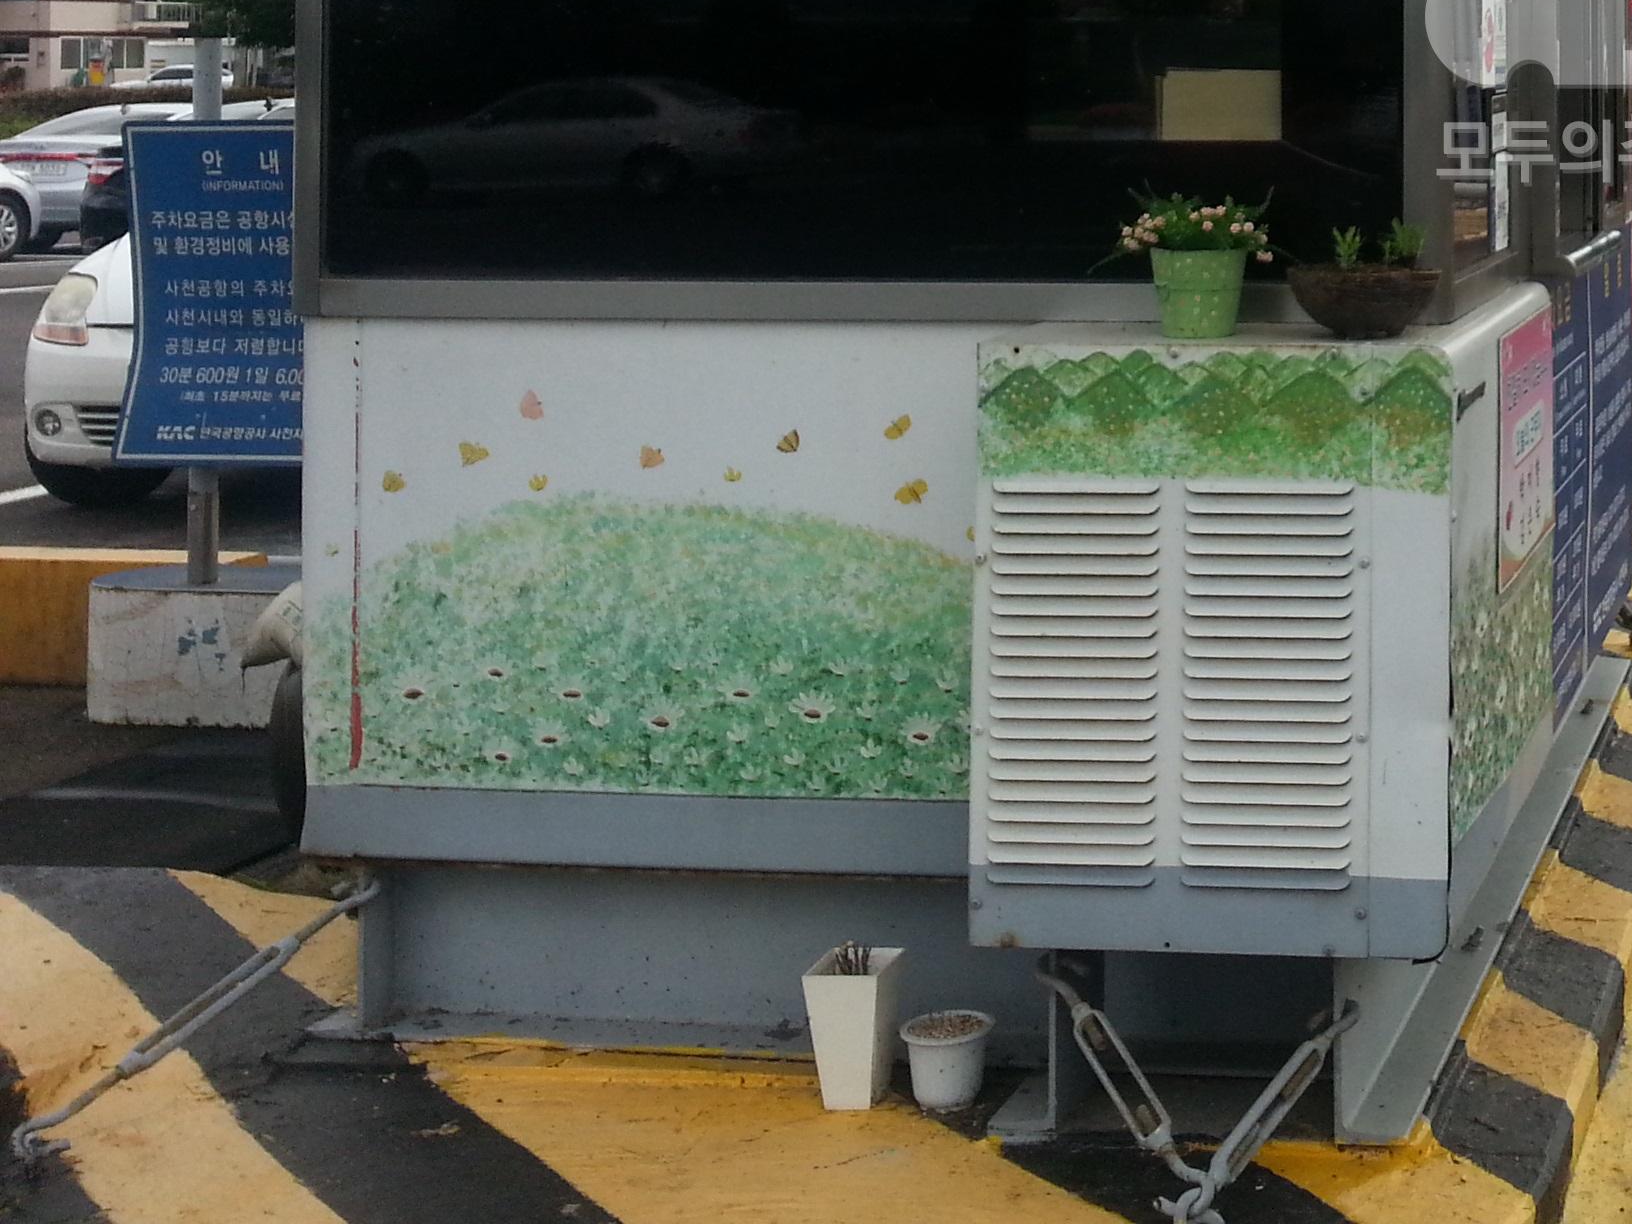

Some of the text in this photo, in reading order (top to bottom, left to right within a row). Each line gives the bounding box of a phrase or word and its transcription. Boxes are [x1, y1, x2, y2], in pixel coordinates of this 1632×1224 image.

[151, 210, 231, 230] 주차요금은
[153, 236, 168, 256] 및
[174, 236, 252, 256] 환경정비에
[164, 278, 244, 298] 사천공항의
[165, 308, 244, 327] 사천시내와
[165, 337, 226, 356] 공항보다
[160, 366, 192, 384] 30분
[196, 365, 240, 384] 600원
[156, 424, 196, 441] KAC
